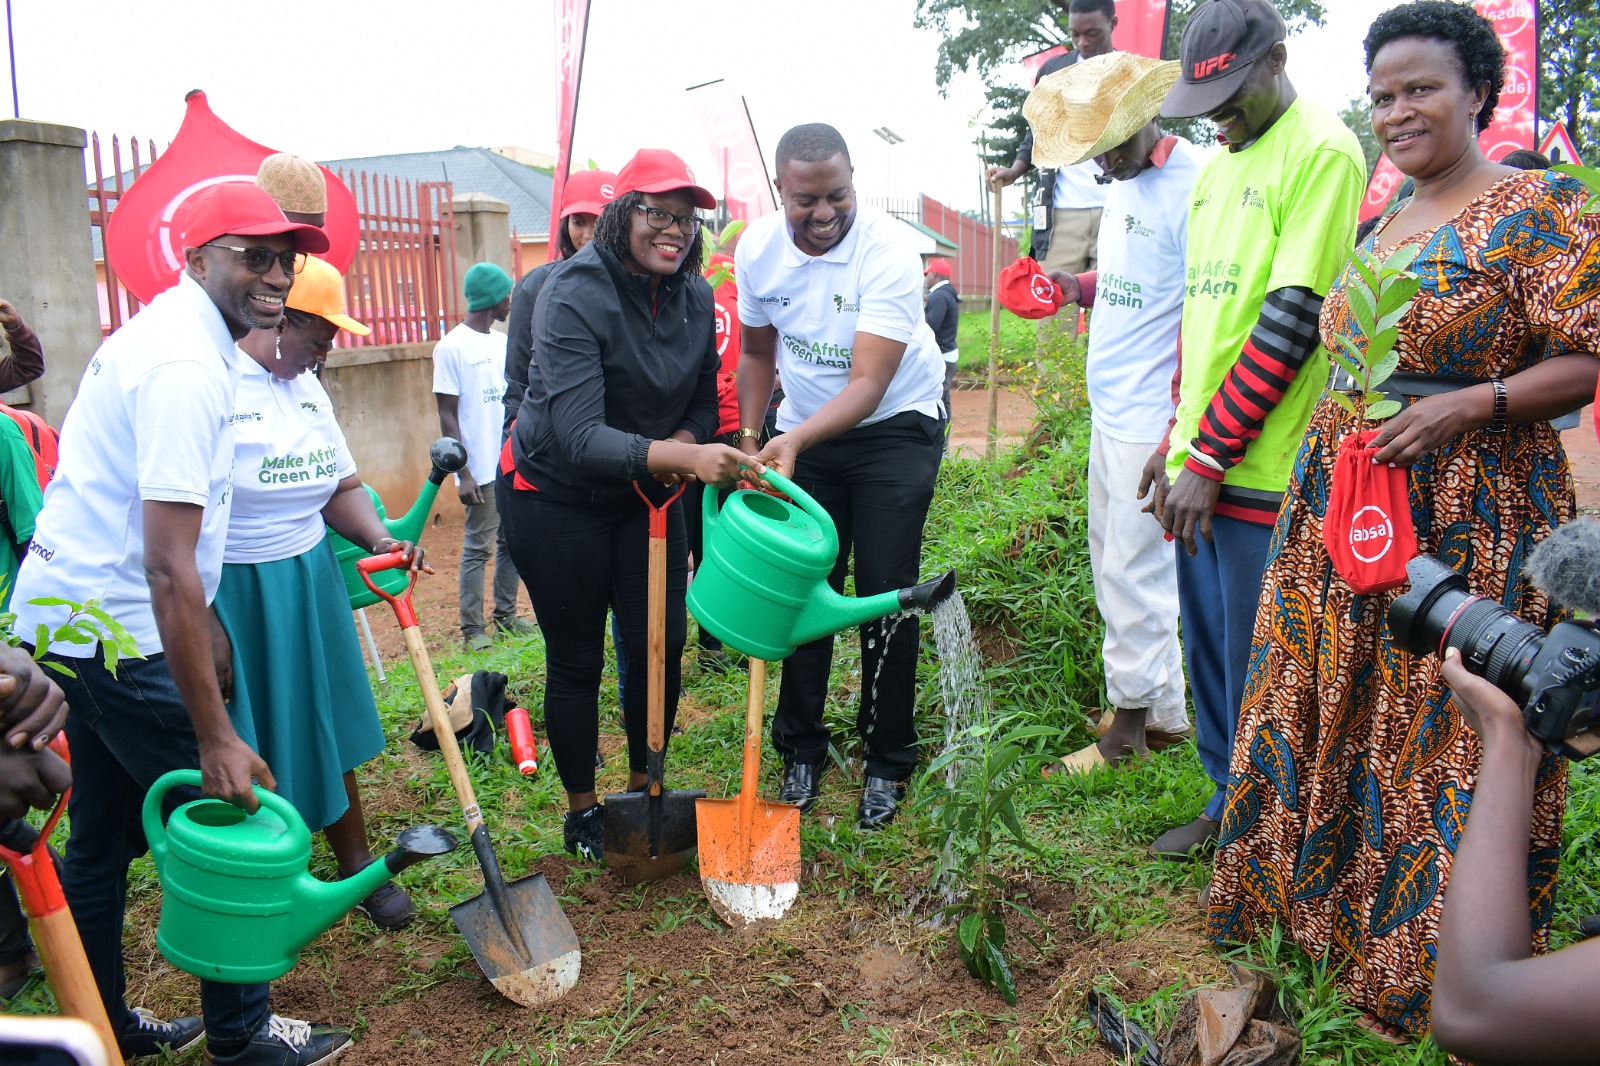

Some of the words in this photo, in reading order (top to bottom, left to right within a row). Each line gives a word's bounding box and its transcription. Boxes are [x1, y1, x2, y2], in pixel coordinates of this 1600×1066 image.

[1194, 52, 1232, 79] UFC
[1102, 272, 1142, 294] Africa
[1101, 286, 1143, 310] Again
[783, 335, 813, 363] Green
[261, 455, 304, 469] Make
[258, 470, 311, 484] Green
[1353, 524, 1387, 542] absa
